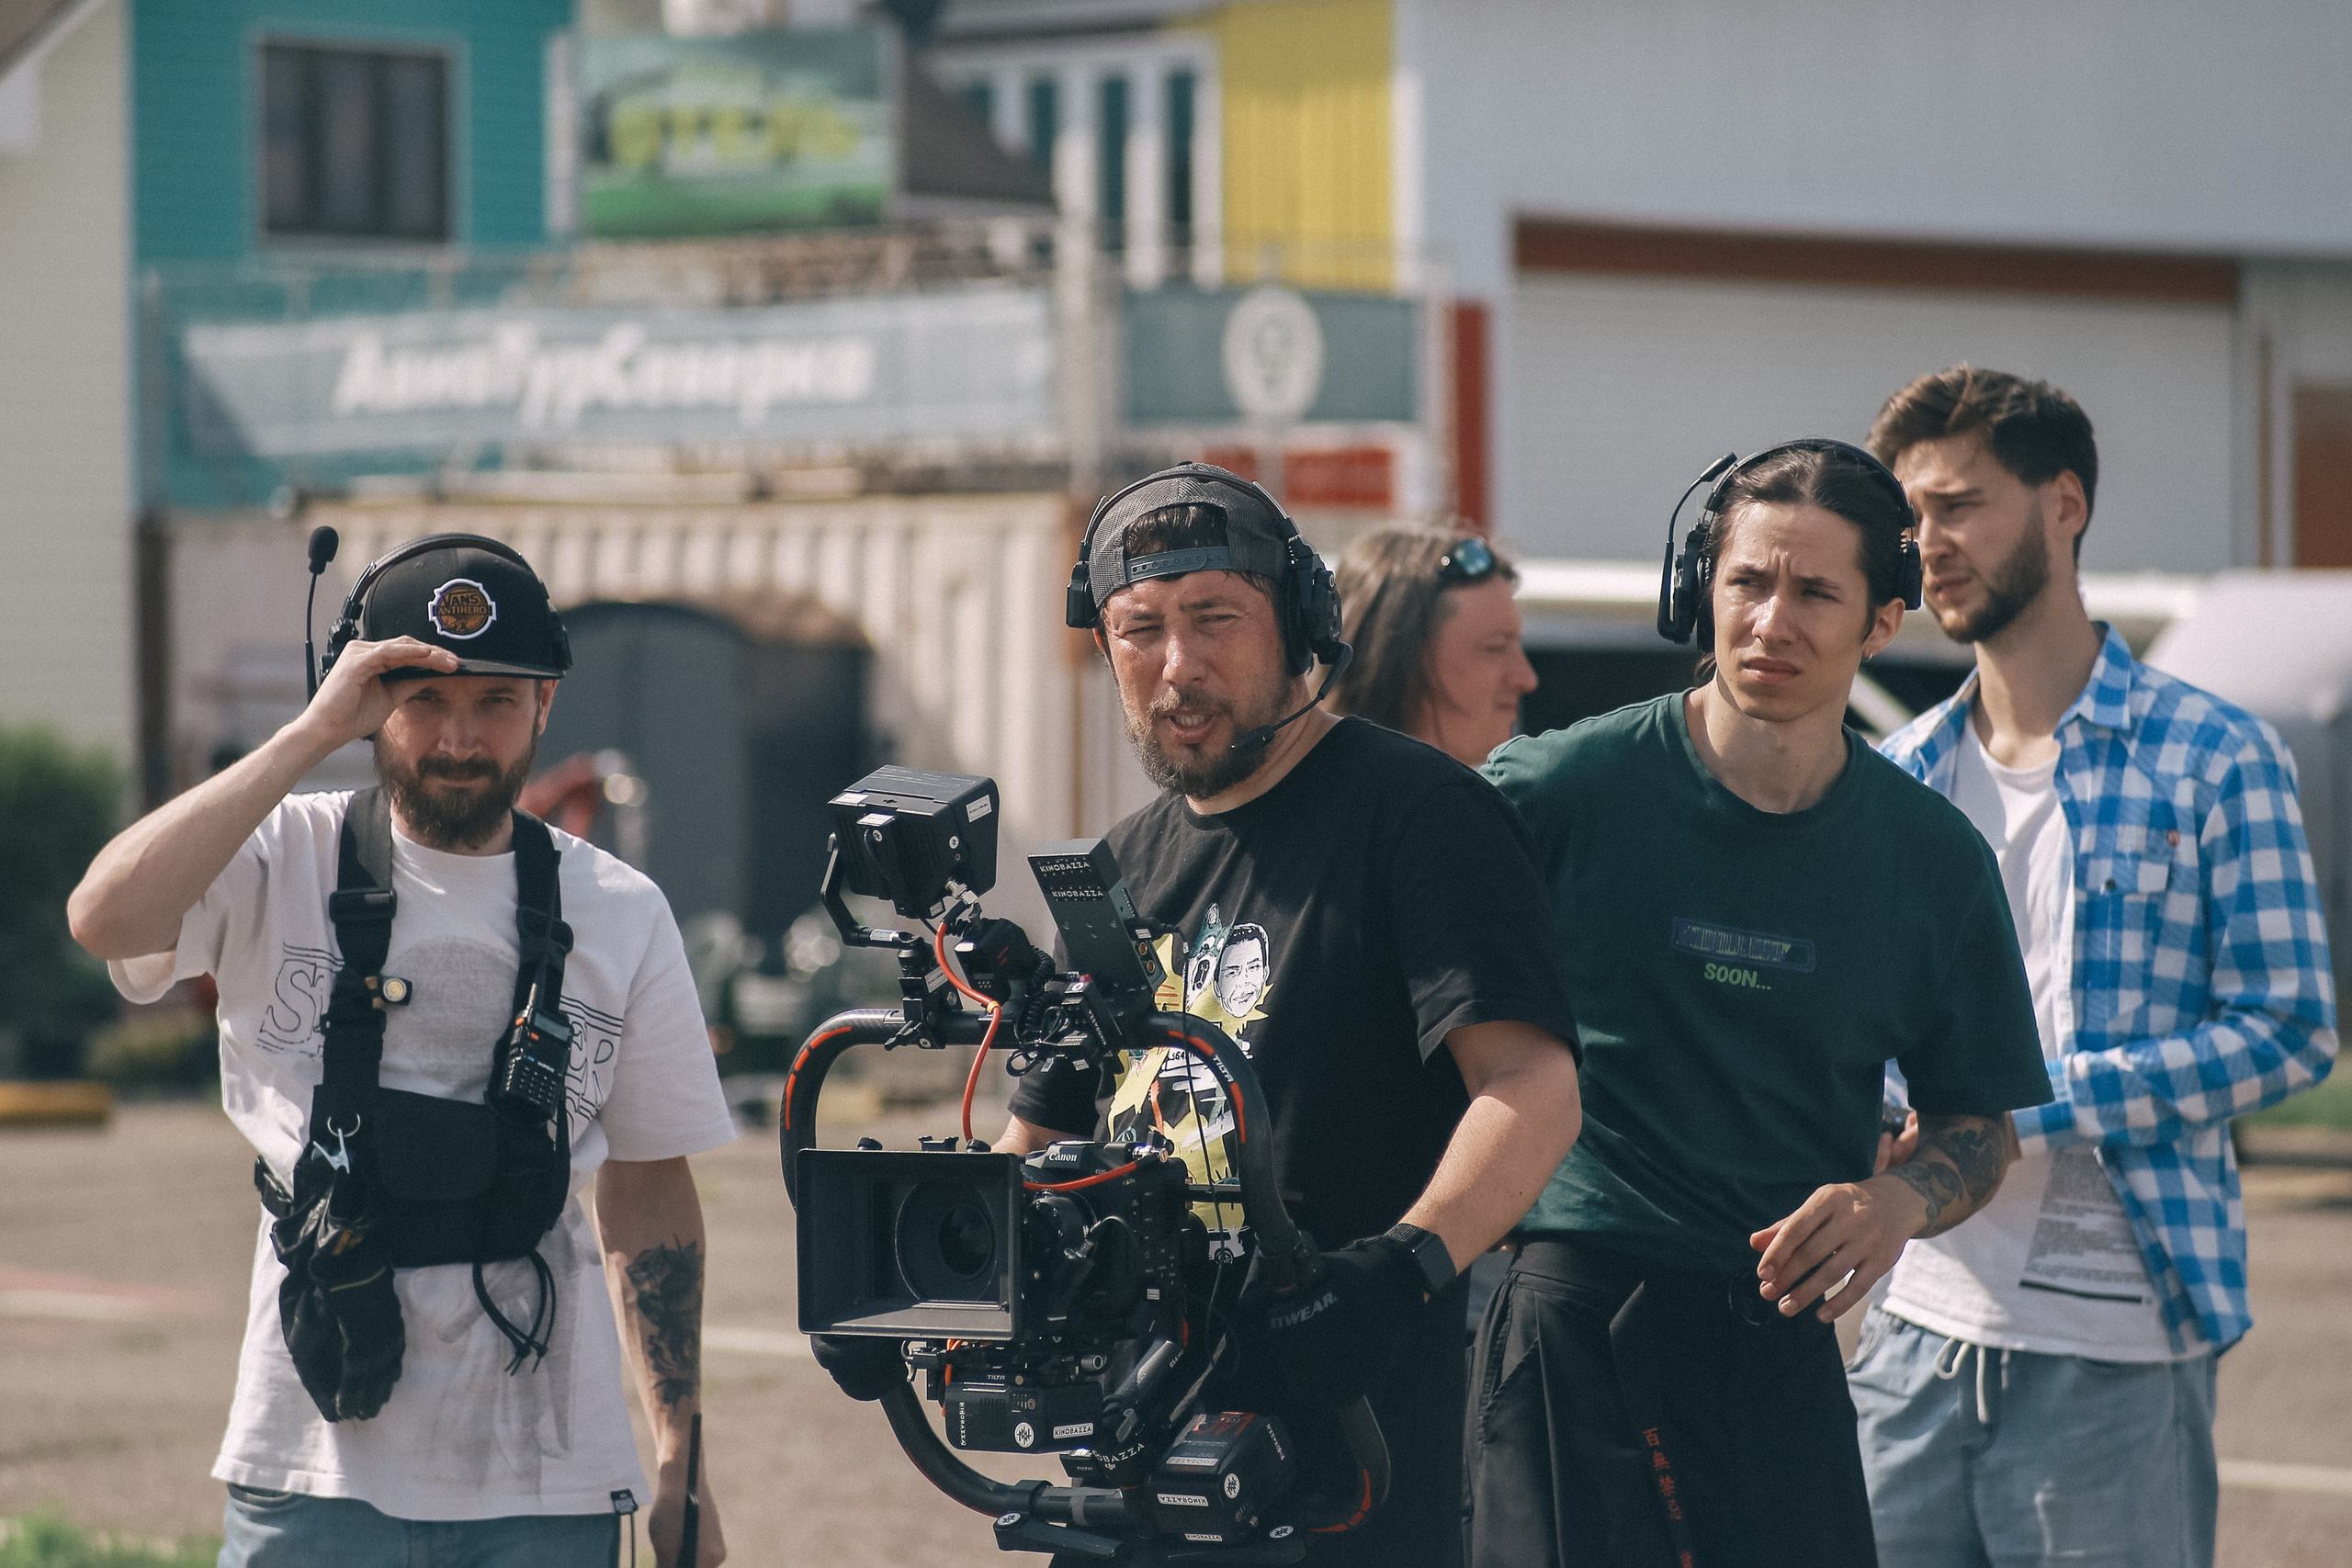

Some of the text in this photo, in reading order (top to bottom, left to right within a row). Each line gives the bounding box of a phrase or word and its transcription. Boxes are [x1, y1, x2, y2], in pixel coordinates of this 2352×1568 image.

[441, 591, 478, 606] VANS
[438, 606, 487, 615] ANTIHERO
[1039, 862, 1091, 873] KINOBAZZA
[1704, 963, 1771, 990] SOON...
[1214, 1055, 1235, 1083] TILTA
[1048, 1153, 1078, 1162] Canon
[958, 1402, 967, 1447] KINOBAZZA
[1054, 1426, 1092, 1436] KINOBAZZA
[1159, 1495, 1207, 1505] KINOBAZZA
